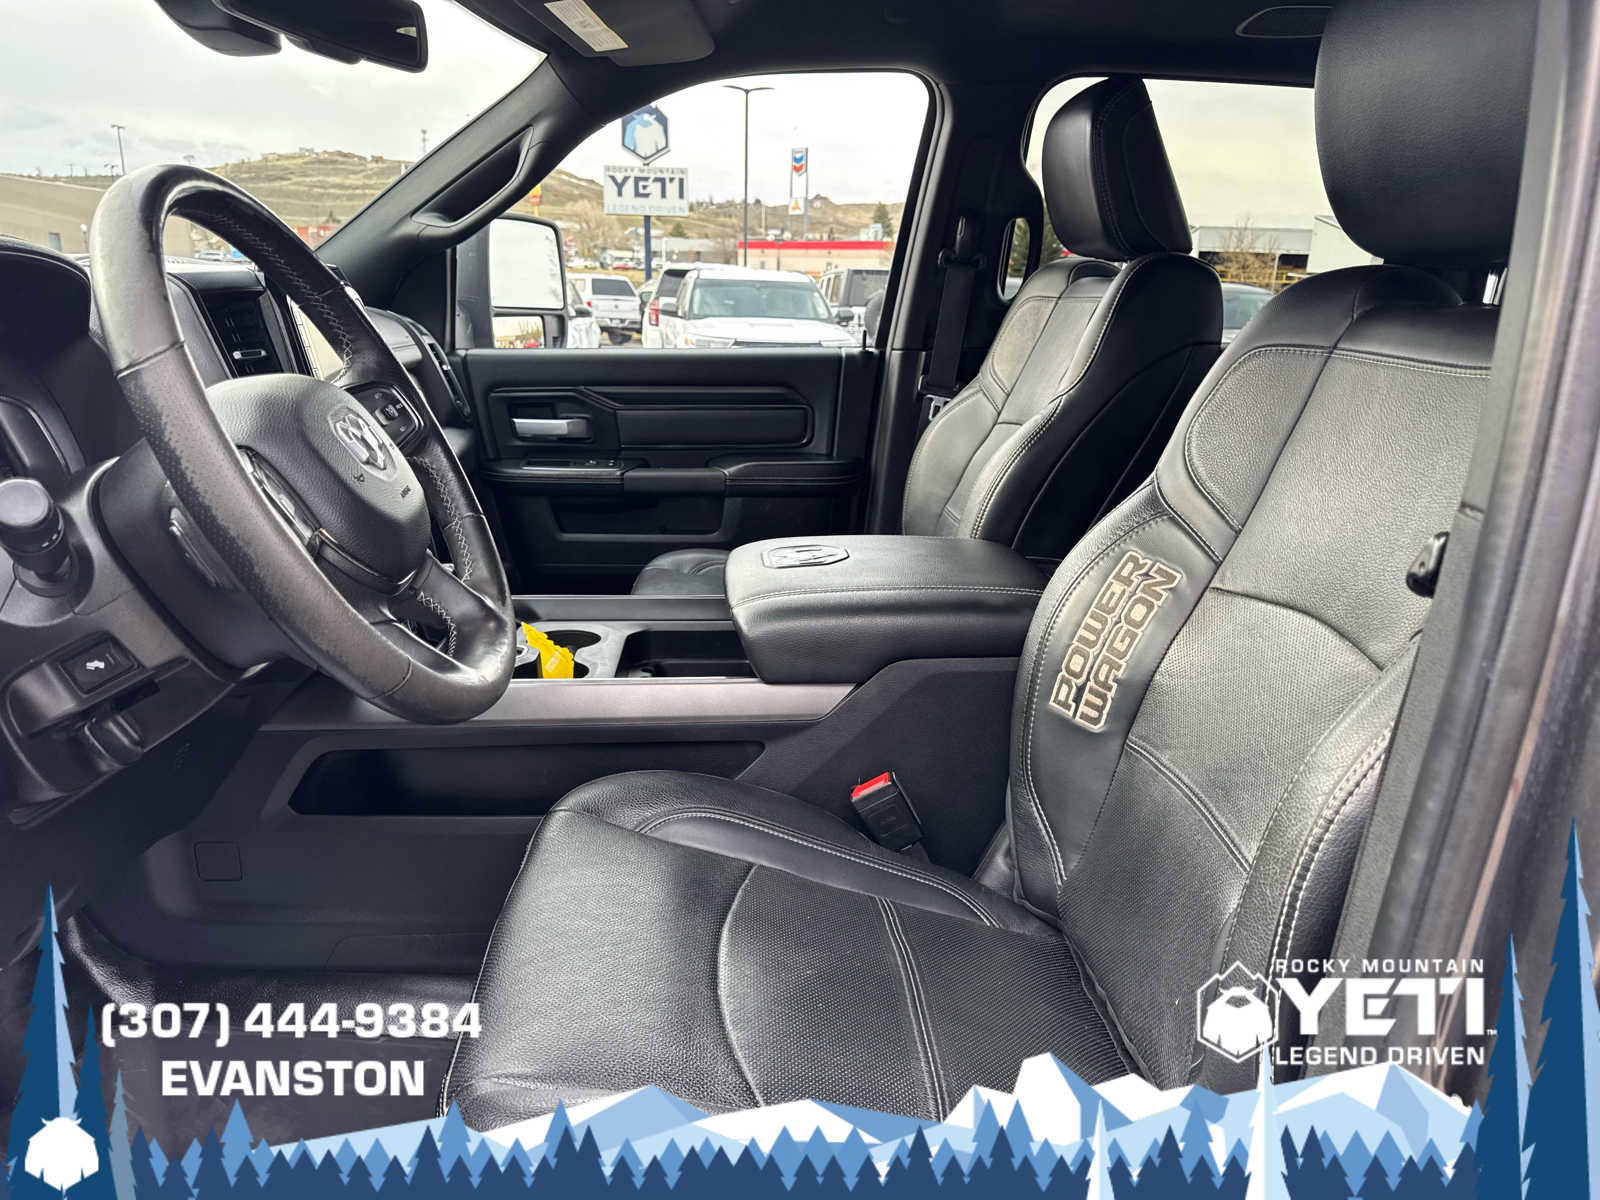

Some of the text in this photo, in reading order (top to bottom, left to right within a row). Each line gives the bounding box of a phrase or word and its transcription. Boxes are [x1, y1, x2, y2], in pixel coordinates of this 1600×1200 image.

[608, 176, 684, 199] YETI
[1049, 550, 1151, 717] POWER
[1075, 562, 1183, 731] WAGON
